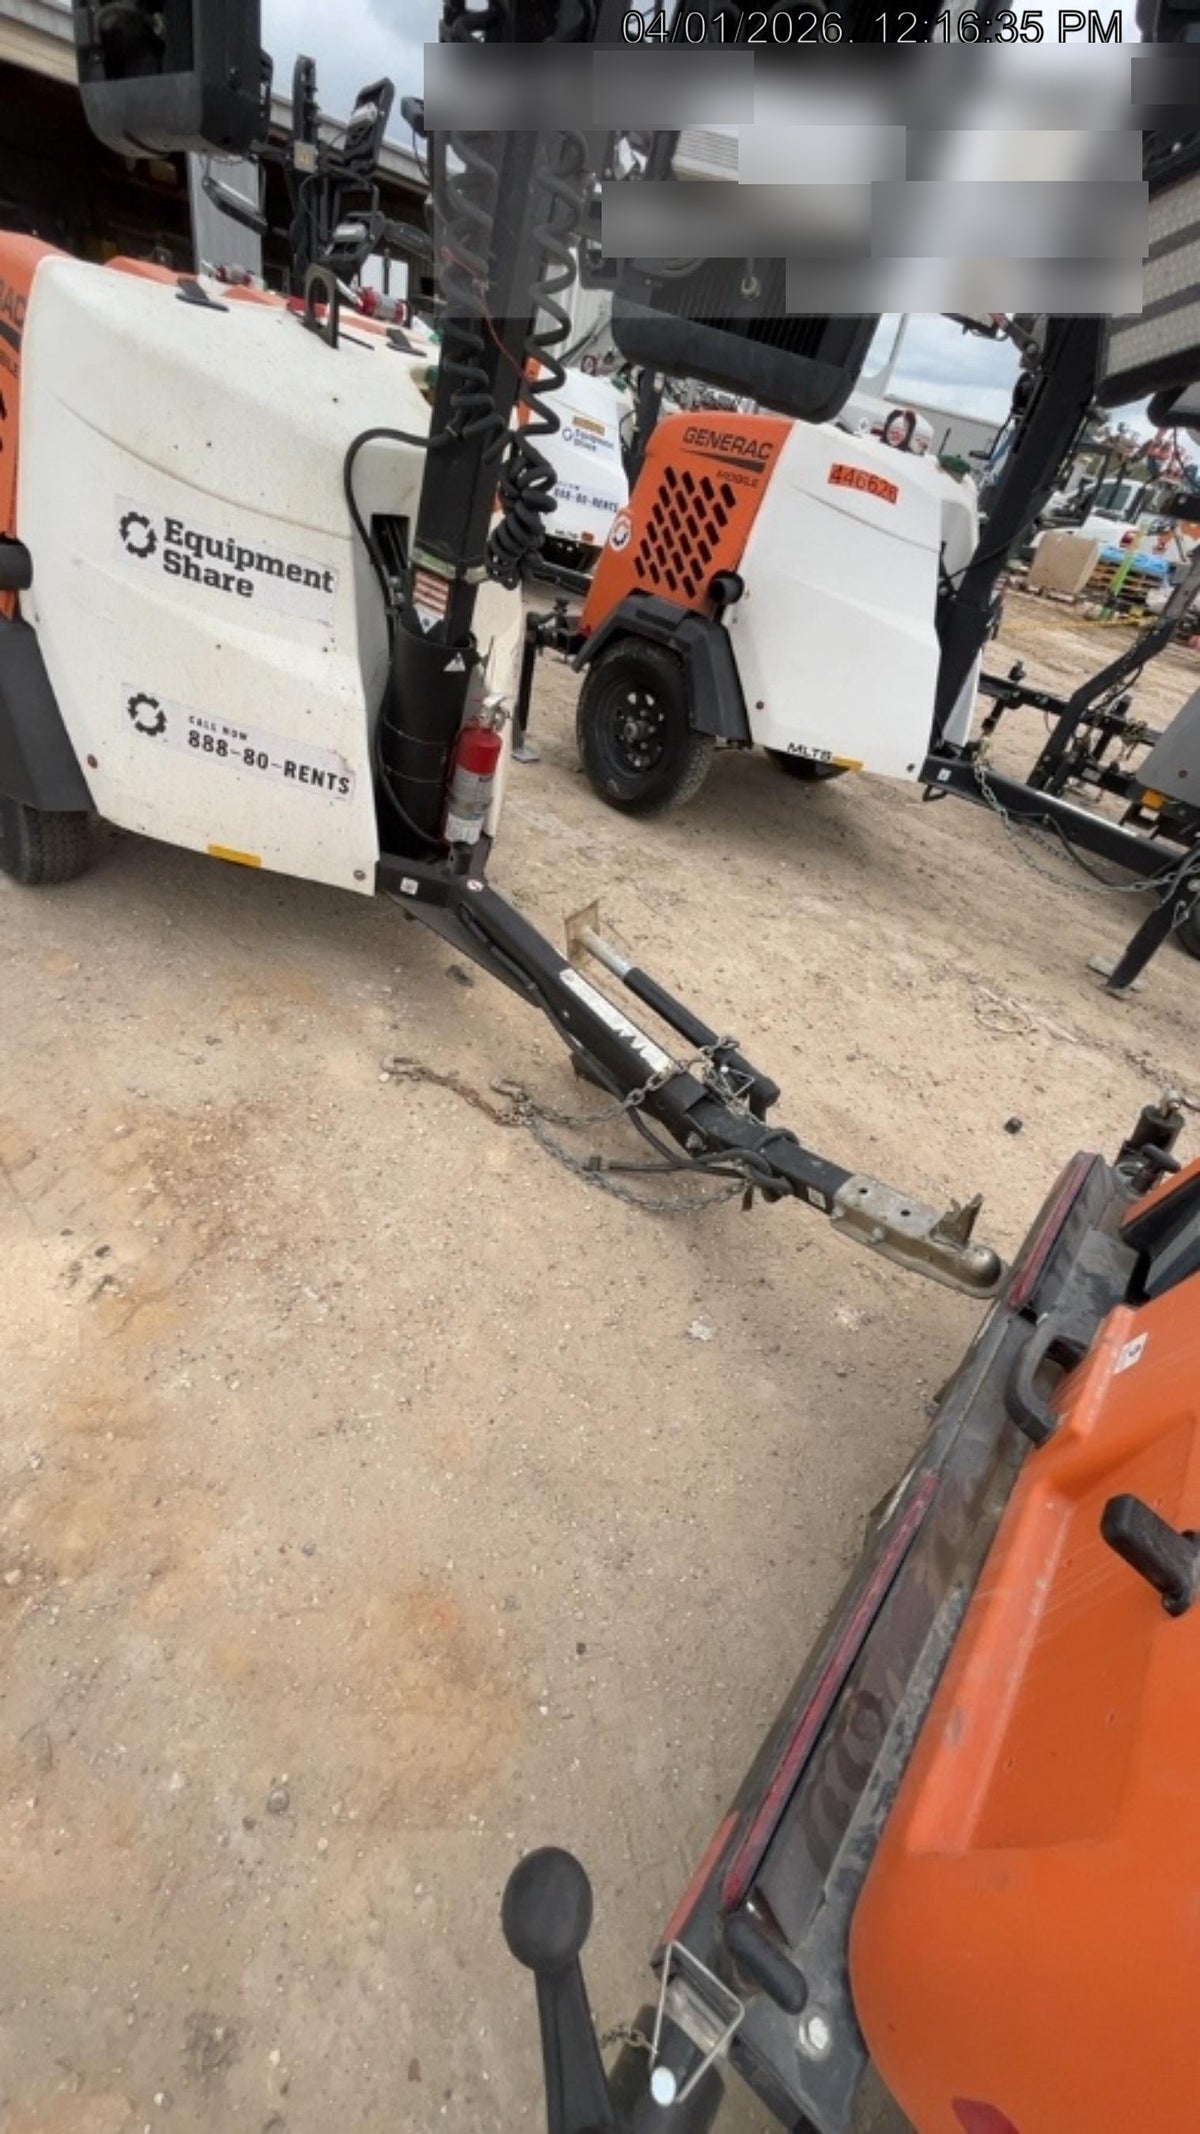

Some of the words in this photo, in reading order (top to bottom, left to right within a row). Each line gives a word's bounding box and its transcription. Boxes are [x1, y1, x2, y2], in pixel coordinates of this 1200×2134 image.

[682, 426, 774, 460] GENERAC
[715, 469, 760, 488] MOBILE
[163, 549, 254, 598] Share
[164, 517, 334, 593] Equipment
[188, 715, 216, 732] CALL
[222, 726, 248, 741] NOW
[188, 729, 350, 795] 888-80-RENTS
